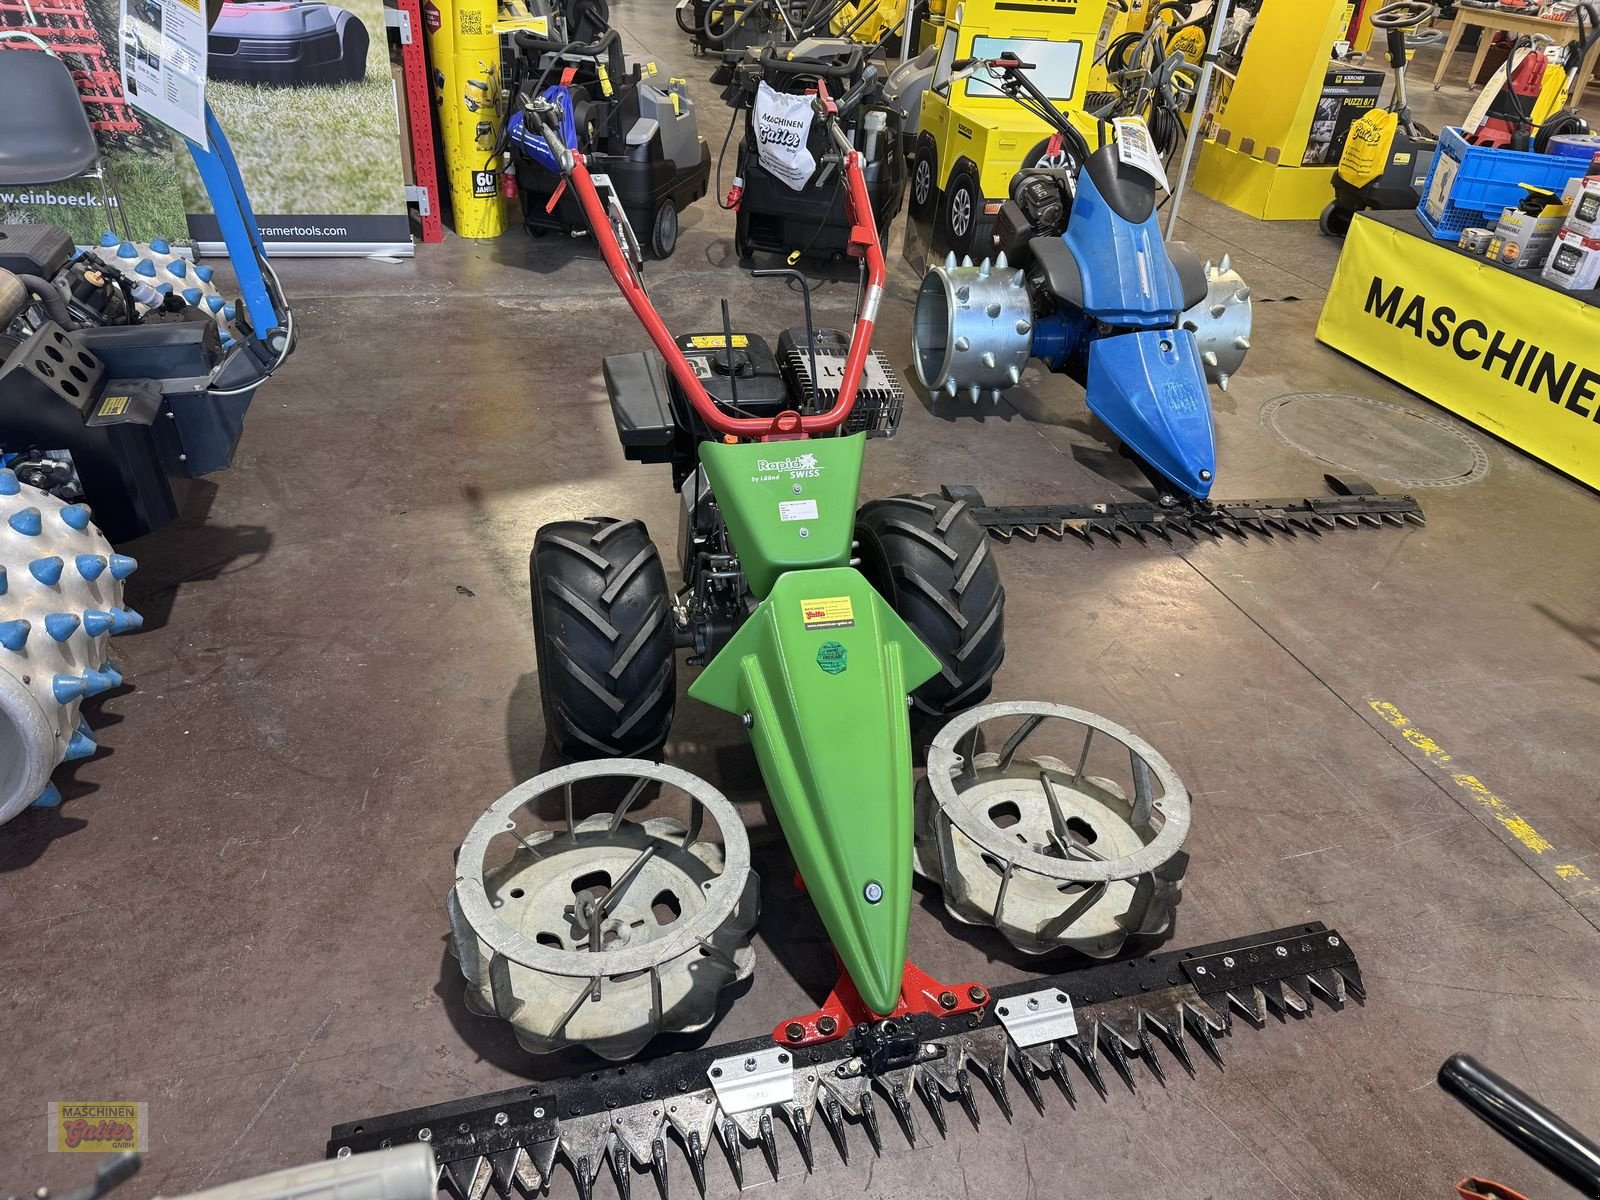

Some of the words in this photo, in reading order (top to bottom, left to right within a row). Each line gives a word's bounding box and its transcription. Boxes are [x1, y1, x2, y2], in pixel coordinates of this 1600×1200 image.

[1343, 97, 1362, 106] PUZZI
[476, 172, 494, 187] 60
[1364, 276, 1600, 424] MASCHINE
[757, 456, 802, 472] Rapid
[790, 469, 820, 479] SWISS
